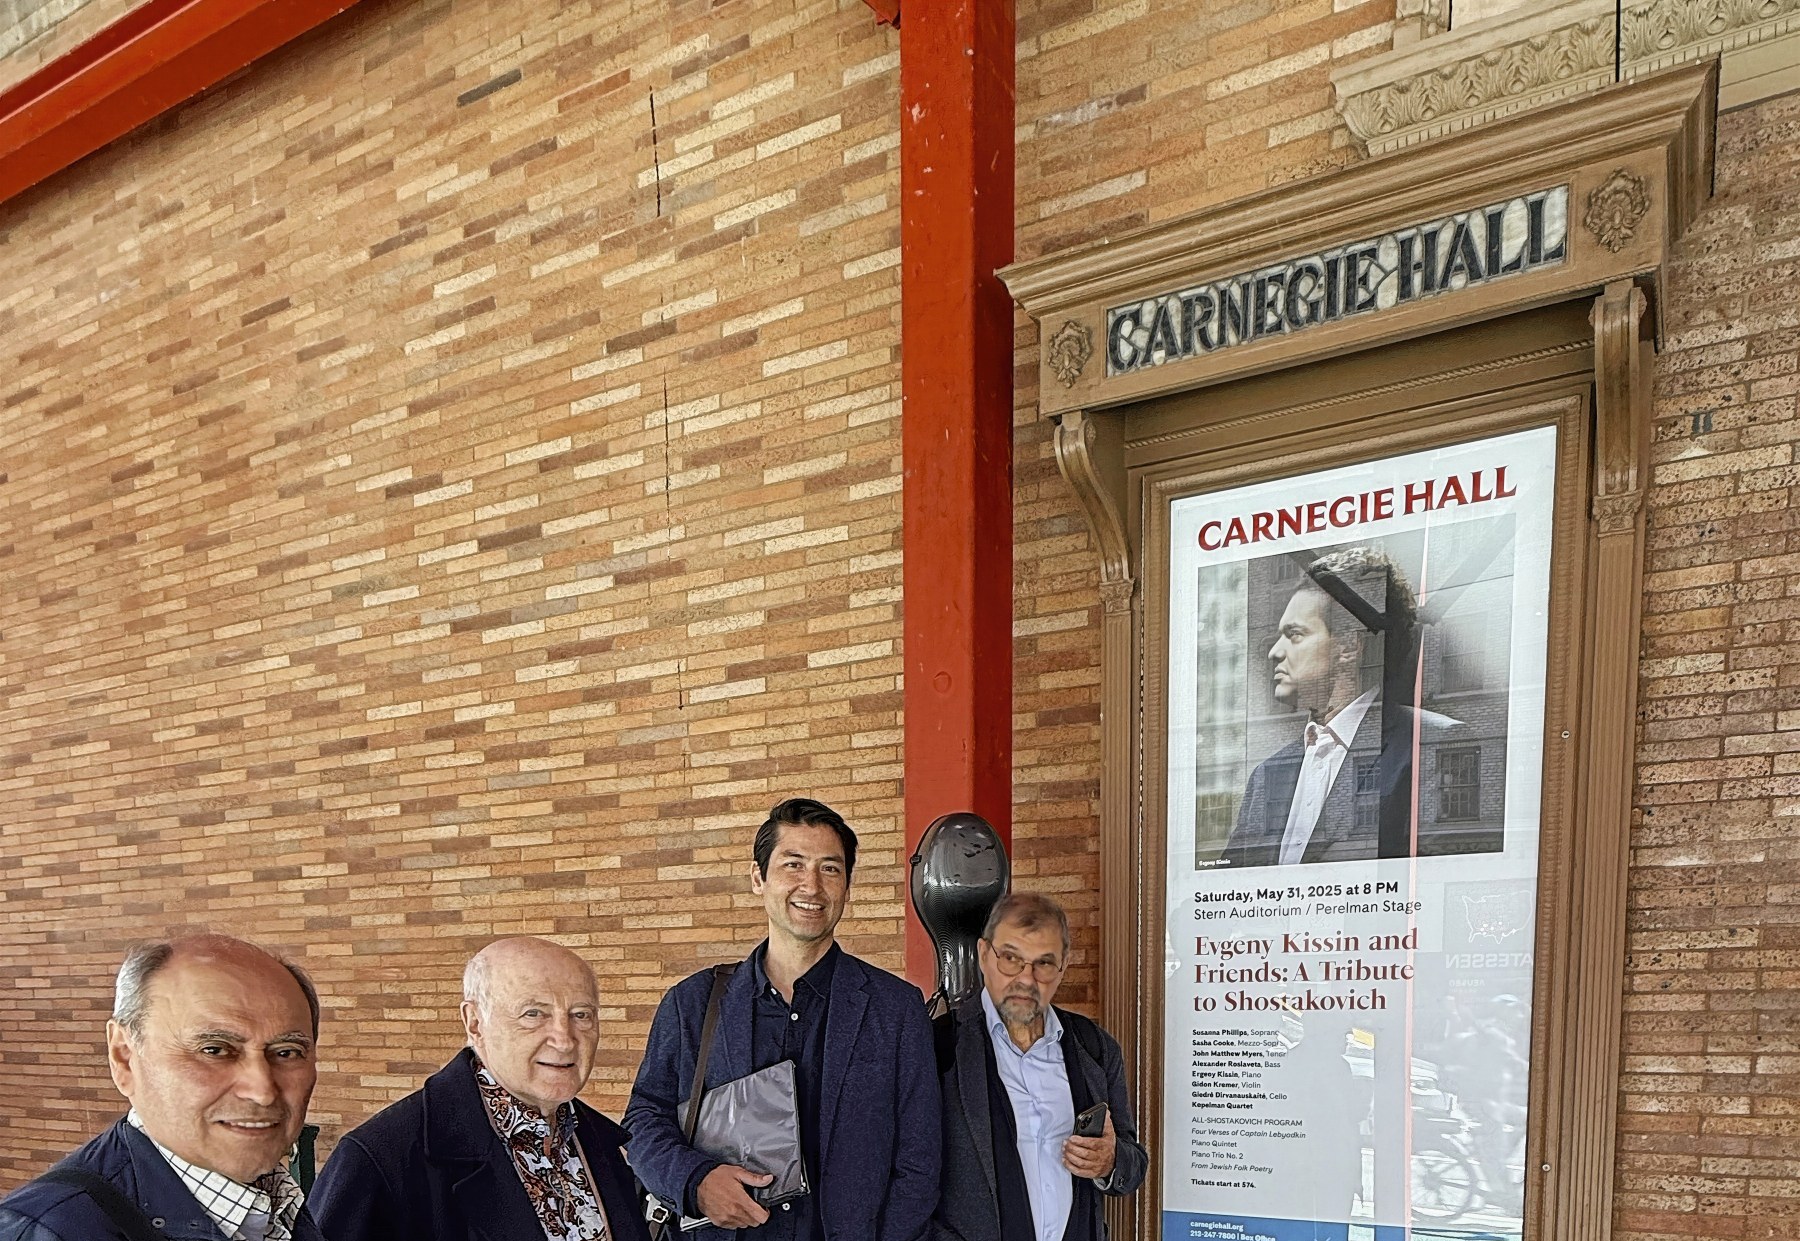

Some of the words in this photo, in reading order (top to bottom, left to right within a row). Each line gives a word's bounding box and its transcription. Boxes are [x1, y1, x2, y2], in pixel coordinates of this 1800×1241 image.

[1107, 246, 1379, 371] CARNEGIE
[1399, 198, 1567, 303] HALL
[1197, 487, 1395, 551] CARNEGIE
[1402, 464, 1518, 516] HALL
[1194, 889, 1253, 903] Saturday,
[1256, 888, 1284, 902] May
[1287, 887, 1304, 900] 31,
[1307, 885, 1342, 898] 2025
[1345, 885, 1360, 895] at
[1363, 883, 1371, 894] 8
[1375, 881, 1399, 893] PM
[1194, 907, 1226, 920] Stern
[1229, 904, 1302, 919] Auditorium
[1305, 903, 1311, 915] /
[1315, 900, 1378, 915] Perelman
[1382, 900, 1422, 914] Stage
[1194, 936, 1274, 961] Evgeny
[1281, 930, 1360, 954] Kissin
[1368, 927, 1419, 951] and
[1194, 961, 1288, 984] Friends:
[1292, 961, 1310, 982] A
[1318, 958, 1415, 982] Tribute
[1193, 995, 1217, 1012] to
[1224, 988, 1387, 1012] Shostakovich
[1241, 1050, 1265, 1058] Myers,
[1213, 1081, 1240, 1089] Kremer,
[1268, 1092, 1288, 1100] Cello
[1226, 1102, 1253, 1110] Quartet
[1191, 1116, 1263, 1125] ALL-SHOSTAKOVICH
[1264, 1118, 1303, 1127] PROGRAM
[1208, 1128, 1230, 1136] Verses
[1239, 1129, 1268, 1138] Captain
[1268, 1131, 1306, 1140] Lebyadkin
[1191, 1139, 1210, 1147] Piano
[1211, 1140, 1237, 1148] Quintet
[1191, 1150, 1210, 1158] Piano
[1211, 1151, 1225, 1159] Trio
[1226, 1152, 1237, 1160] No.
[1249, 1165, 1273, 1174] Poetry
[1190, 1221, 1244, 1232] carnegiehall.org
